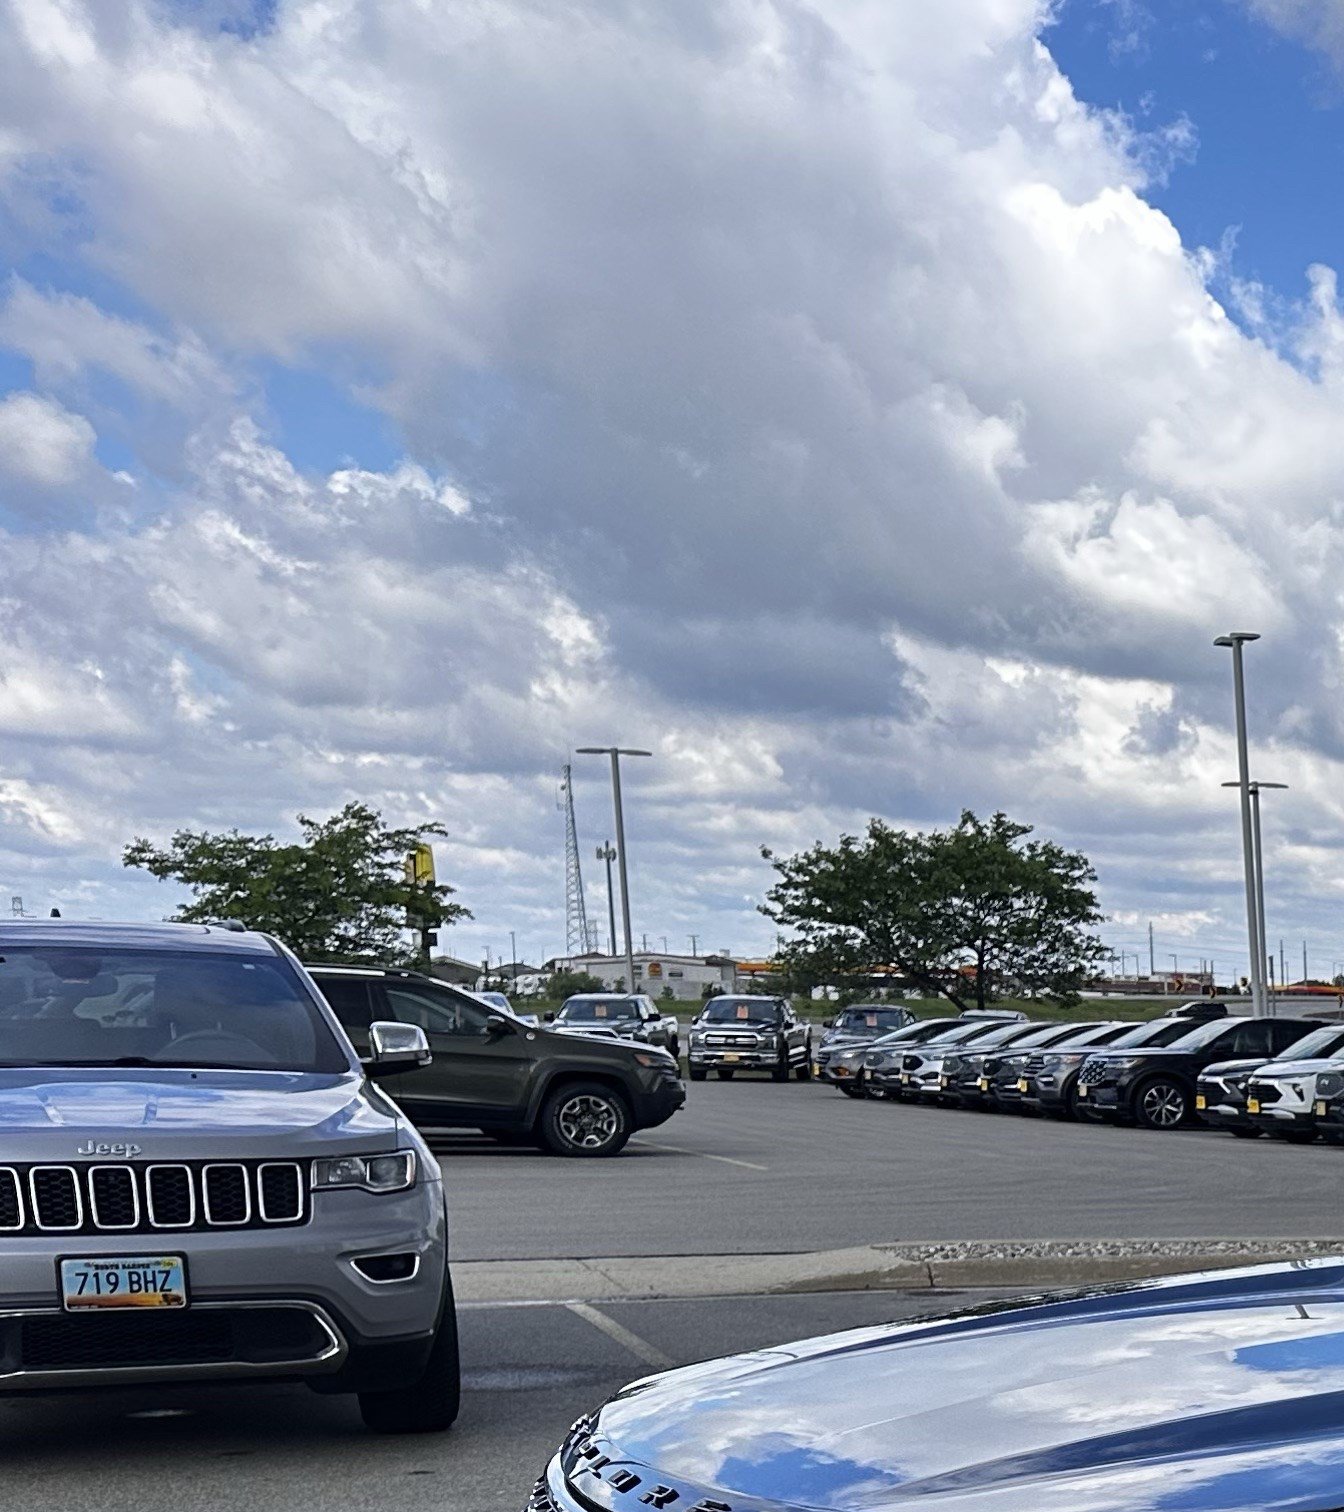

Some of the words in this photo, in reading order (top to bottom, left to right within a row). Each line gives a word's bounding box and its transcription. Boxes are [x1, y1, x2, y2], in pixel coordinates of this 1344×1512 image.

[77, 1140, 142, 1158] Jeep
[75, 1272, 120, 1295] 719
[128, 1270, 173, 1294] BHZ
